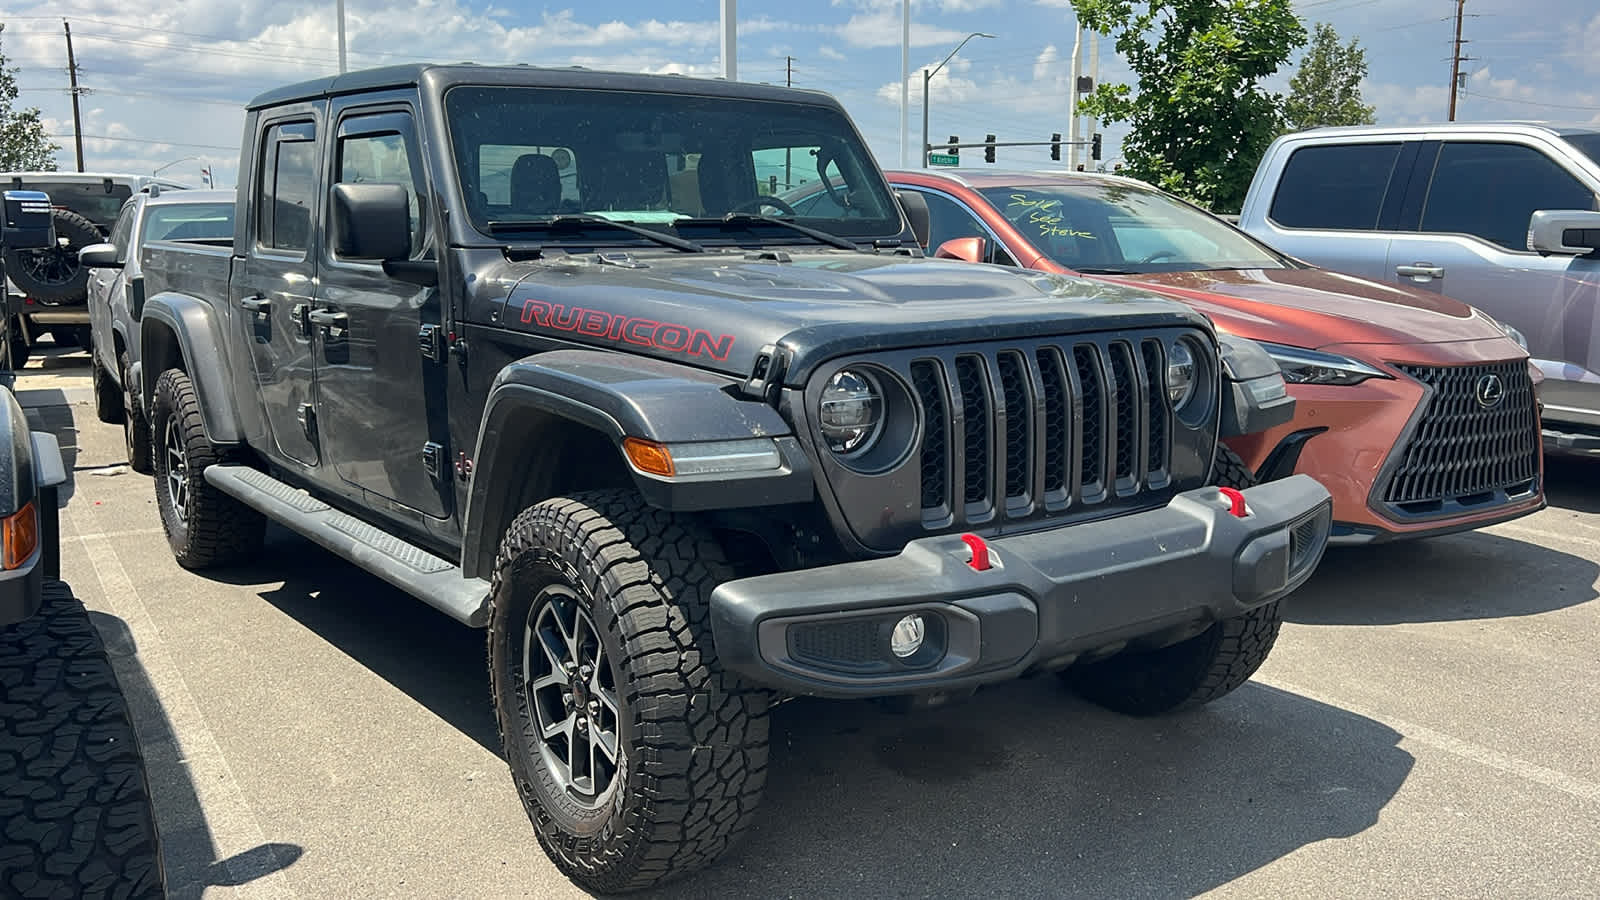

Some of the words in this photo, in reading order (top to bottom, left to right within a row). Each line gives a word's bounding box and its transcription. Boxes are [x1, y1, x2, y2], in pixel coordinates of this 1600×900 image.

[1029, 211, 1062, 224] See
[1039, 224, 1097, 239] Steve
[520, 299, 736, 361] RUBICON
